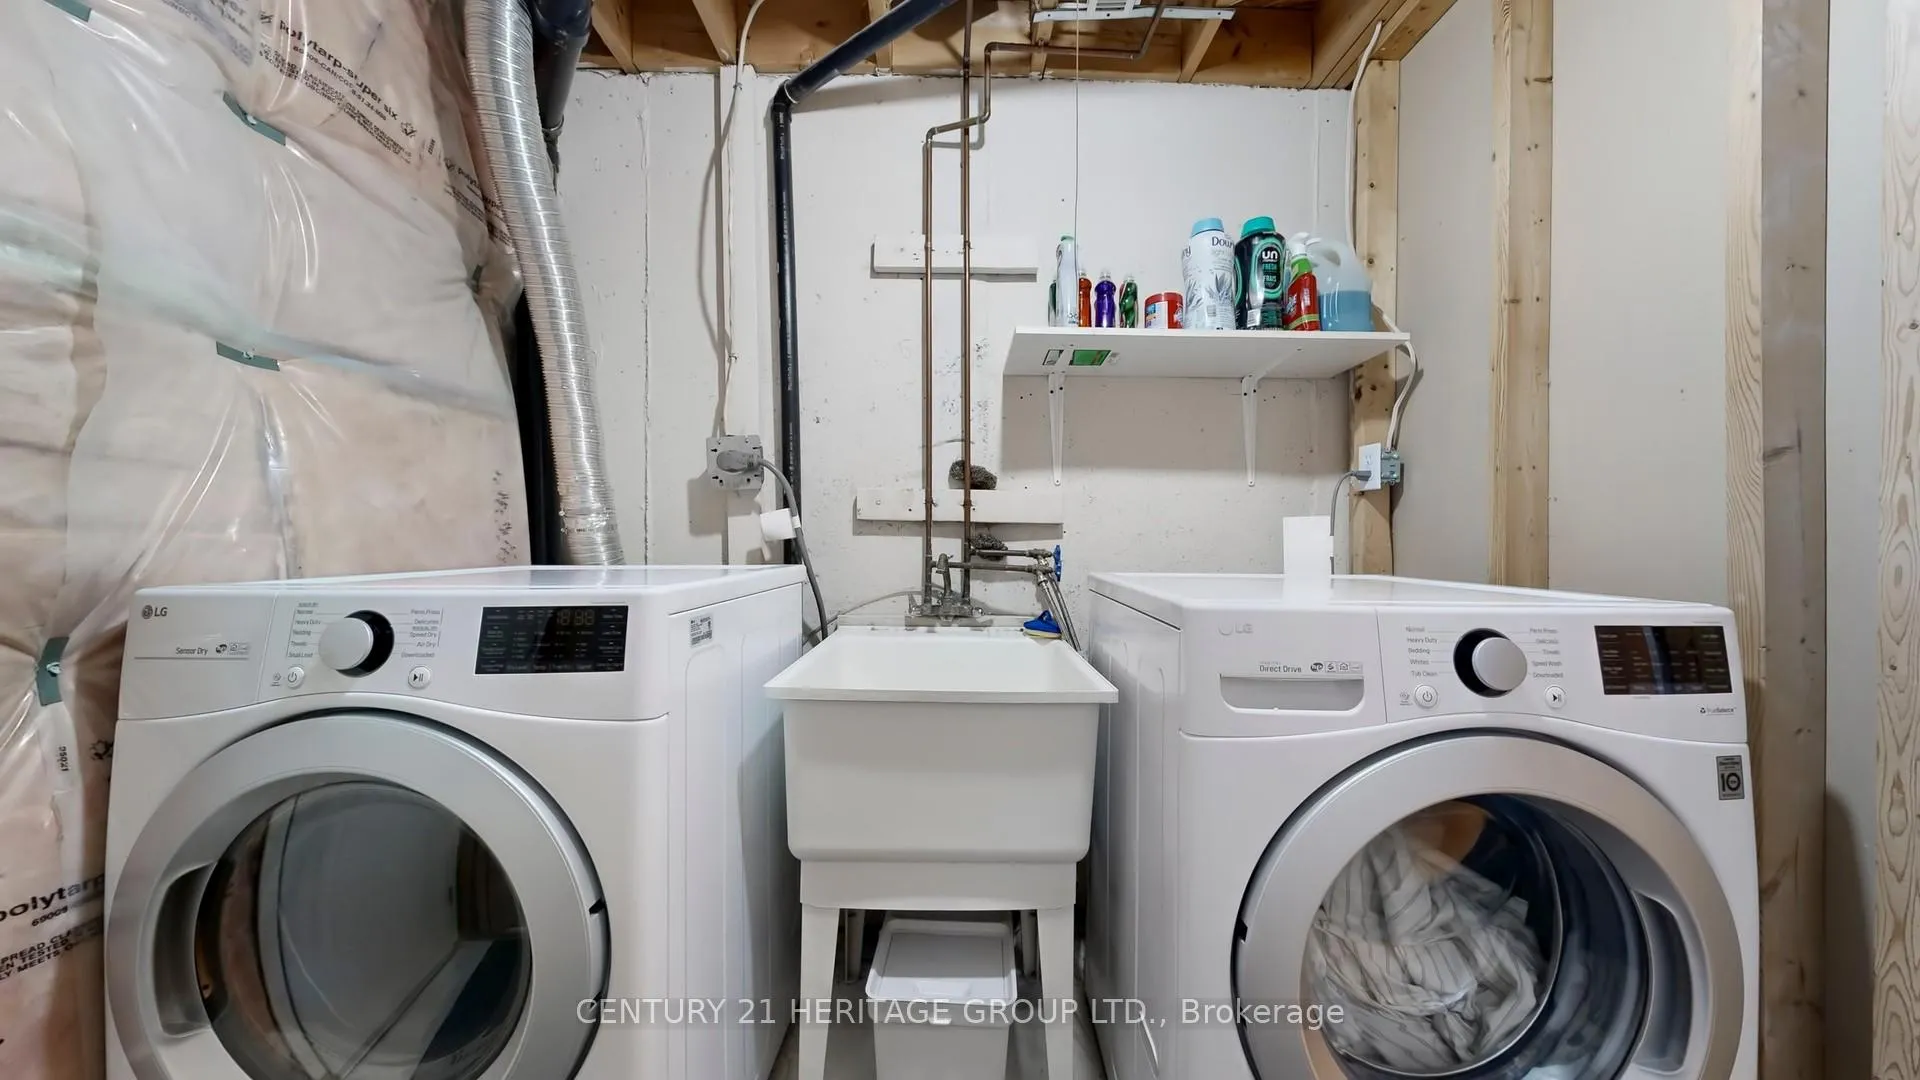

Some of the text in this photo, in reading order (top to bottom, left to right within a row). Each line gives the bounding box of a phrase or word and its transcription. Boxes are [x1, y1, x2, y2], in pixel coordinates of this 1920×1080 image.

[154, 606, 168, 617] LG
[1260, 664, 1281, 673] Direct
[1282, 664, 1302, 673] Drive
